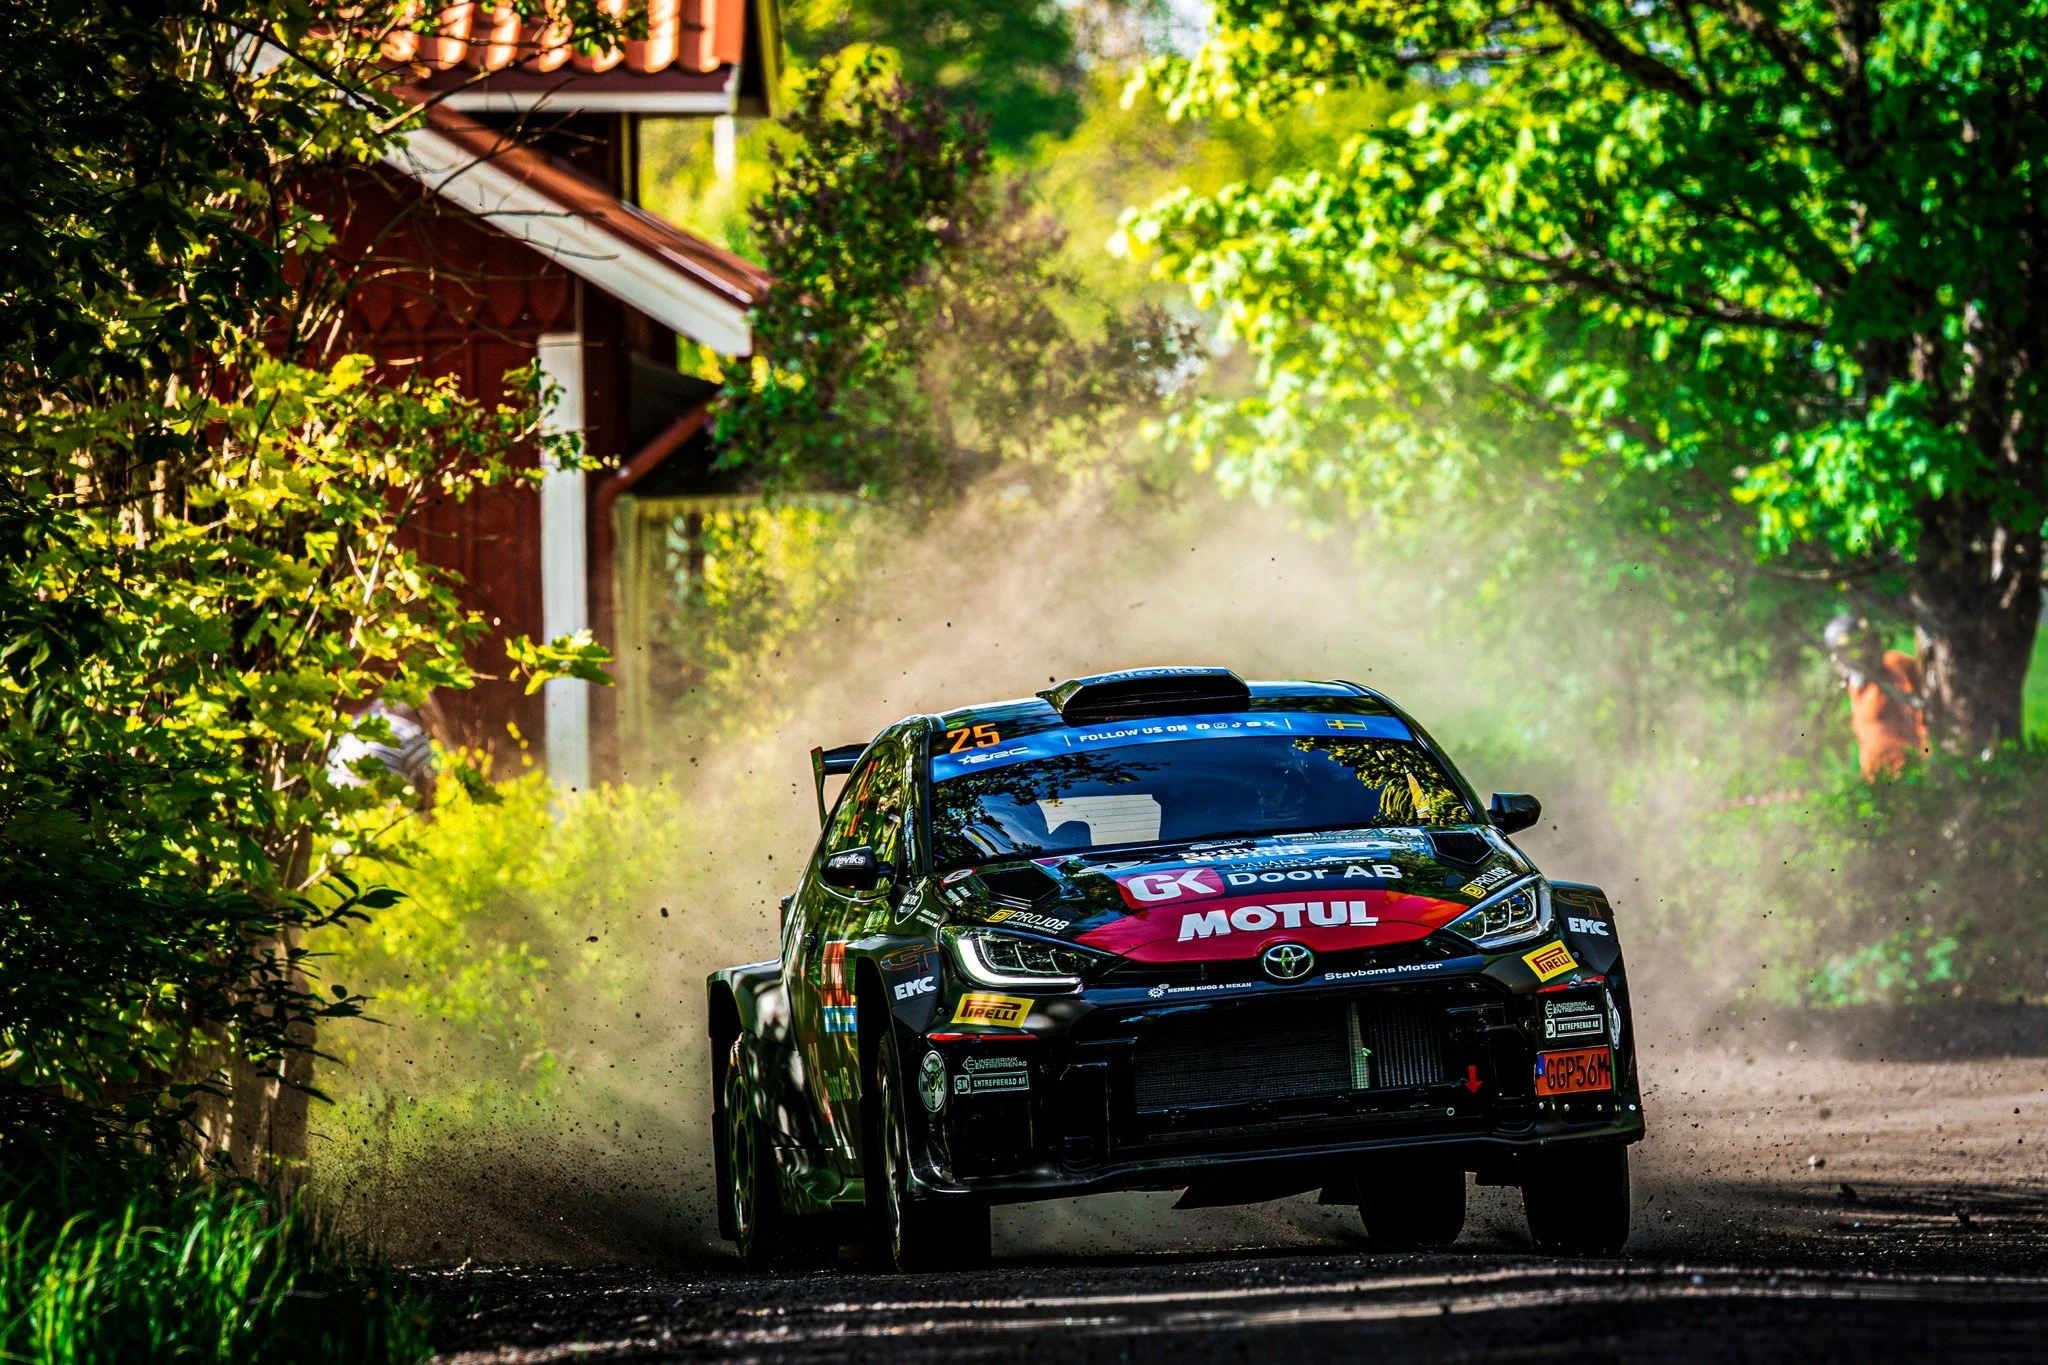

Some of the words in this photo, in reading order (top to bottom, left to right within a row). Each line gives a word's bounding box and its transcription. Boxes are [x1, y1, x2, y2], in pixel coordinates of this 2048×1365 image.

[947, 722, 1000, 753] 25
[1079, 728, 1139, 742] FOLLOW
[1142, 726, 1163, 734] US
[1168, 724, 1188, 733] ON
[962, 746, 1030, 765] ERC
[1127, 869, 1219, 902] GK
[1226, 868, 1329, 886] Door
[1343, 864, 1403, 880] AB
[1008, 911, 1070, 930] PROJOB
[1177, 900, 1379, 942] MOTUL
[1568, 917, 1609, 936] EMC
[1531, 946, 1571, 974] PIRELLI
[1325, 967, 1396, 980] Stavboms
[1397, 963, 1443, 973] Motor
[894, 977, 937, 1001] EMC
[962, 999, 1024, 1022] PIRELLI
[1558, 1021, 1592, 1031] ENTREPRENAD
[1592, 1020, 1599, 1028] AB
[1546, 1053, 1610, 1090] GGP56M
[974, 1079, 1017, 1088] ENTREPRENAD
